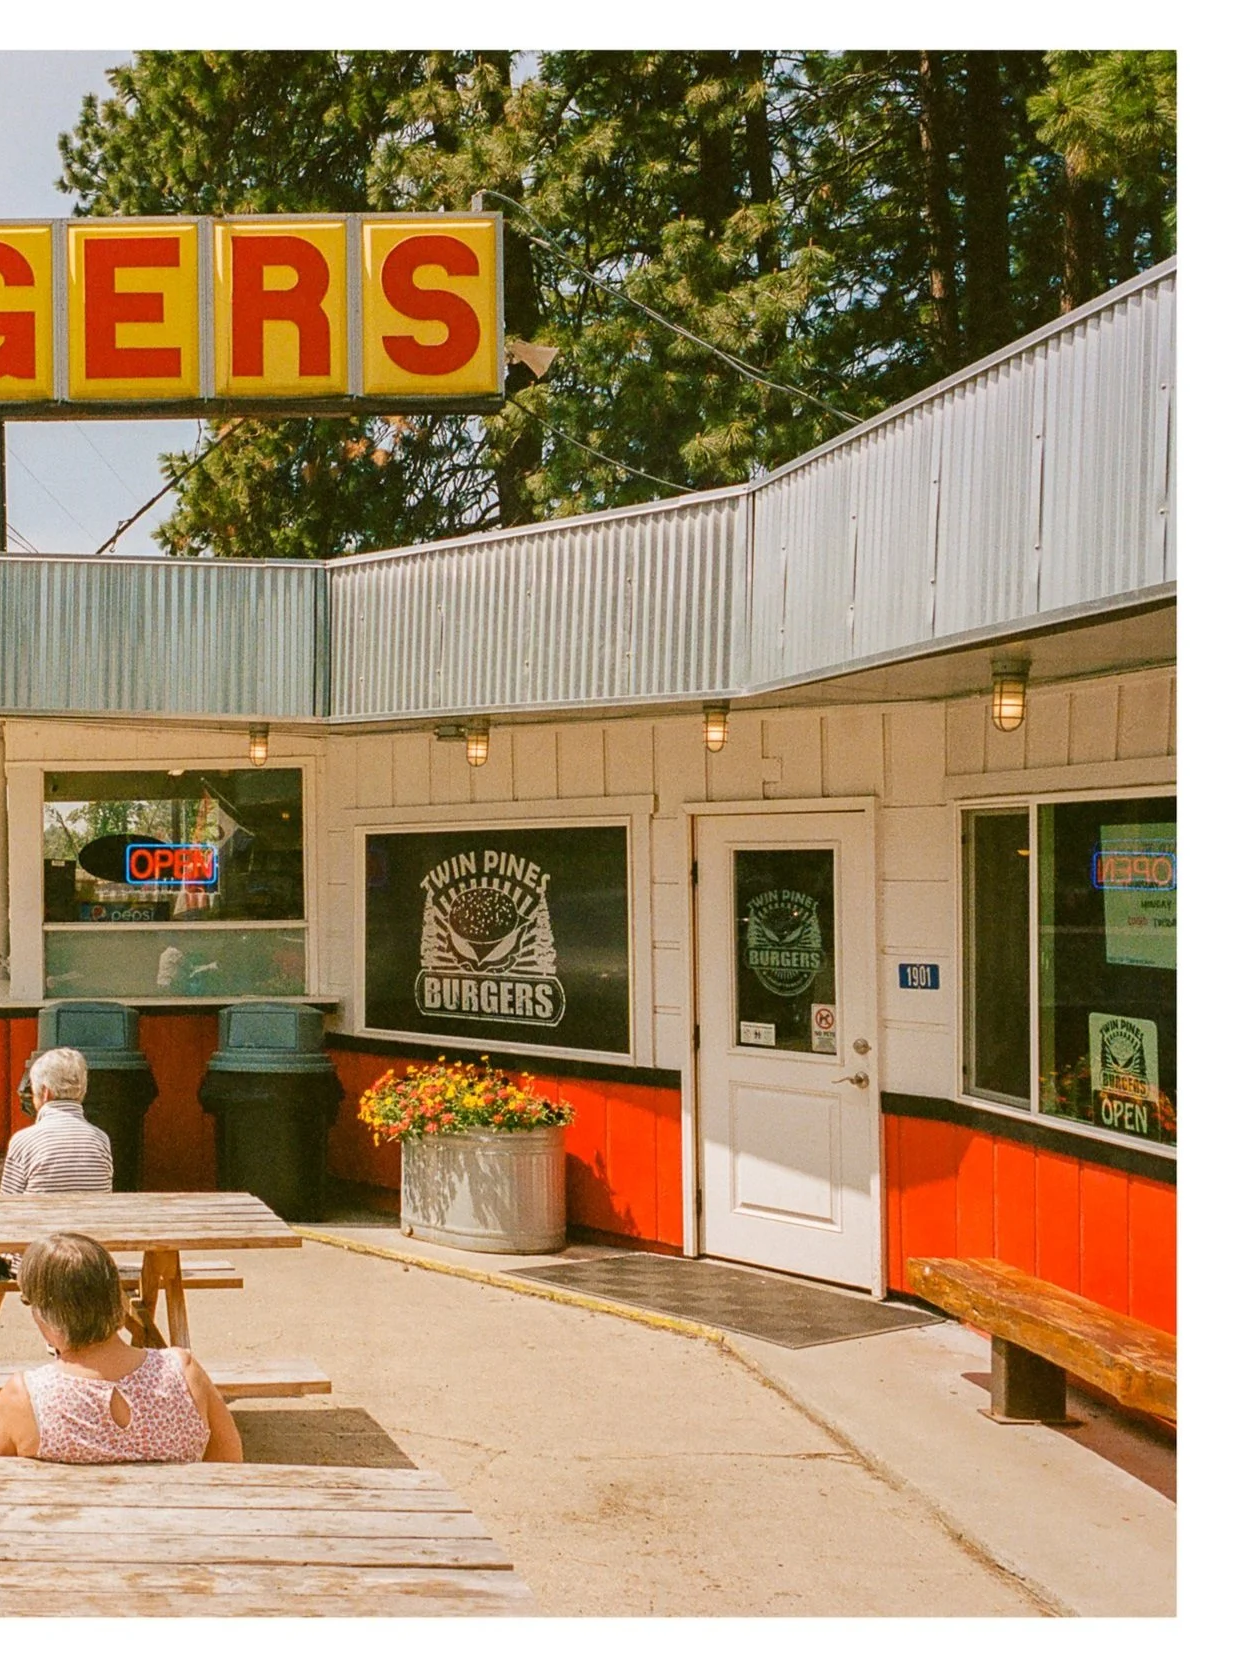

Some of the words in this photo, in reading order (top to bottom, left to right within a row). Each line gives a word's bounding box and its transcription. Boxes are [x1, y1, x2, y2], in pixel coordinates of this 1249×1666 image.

[130, 848, 213, 880] OPEN
[420, 851, 476, 897] TWIN
[484, 850, 550, 893] PINES
[746, 890, 778, 912] TWIN
[111, 907, 154, 923] pepsi
[749, 950, 820, 969] BURGERS
[907, 965, 931, 987] 1901
[424, 977, 553, 1018] BURGERS
[1100, 1019, 1118, 1036] TWIN
[1102, 1072, 1147, 1095] BURGERS
[1101, 1098, 1148, 1134] OPEN
